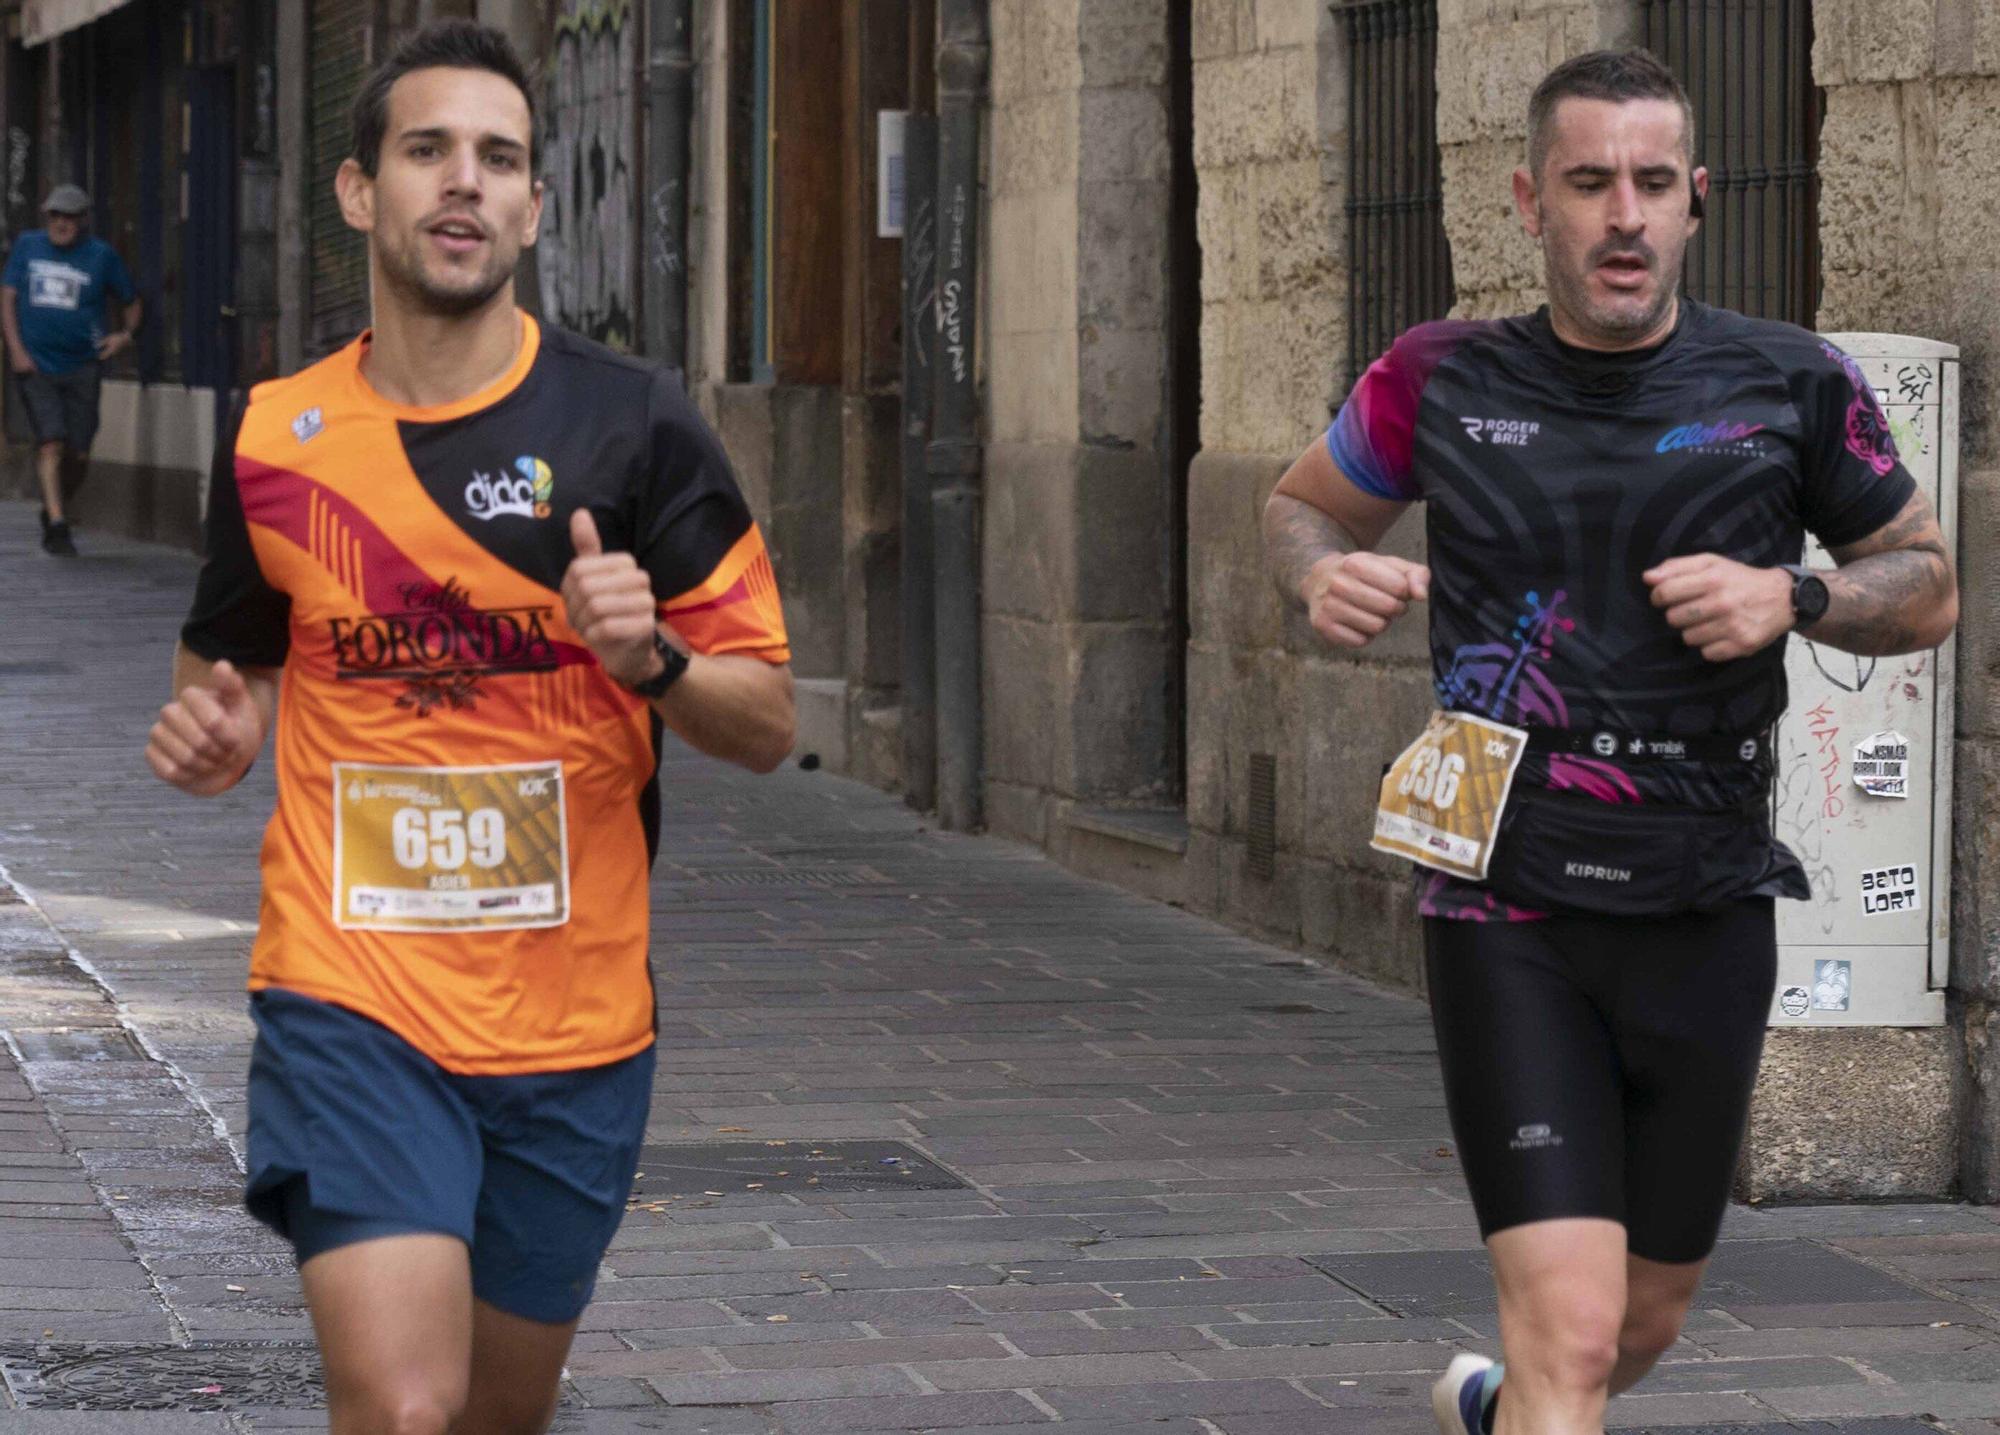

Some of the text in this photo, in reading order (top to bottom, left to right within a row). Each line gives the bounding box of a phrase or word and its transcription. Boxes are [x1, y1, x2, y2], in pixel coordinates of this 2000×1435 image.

[1485, 418, 1540, 435] ROGER
[1492, 431, 1528, 446] BRIZ
[327, 610, 557, 669] FORONDA
[1485, 740, 1509, 760] 10K
[518, 778, 550, 797] 10K
[392, 807, 507, 870] 659
[1565, 862, 1632, 882] KIPRUN
[1864, 888, 1915, 914] LORT
